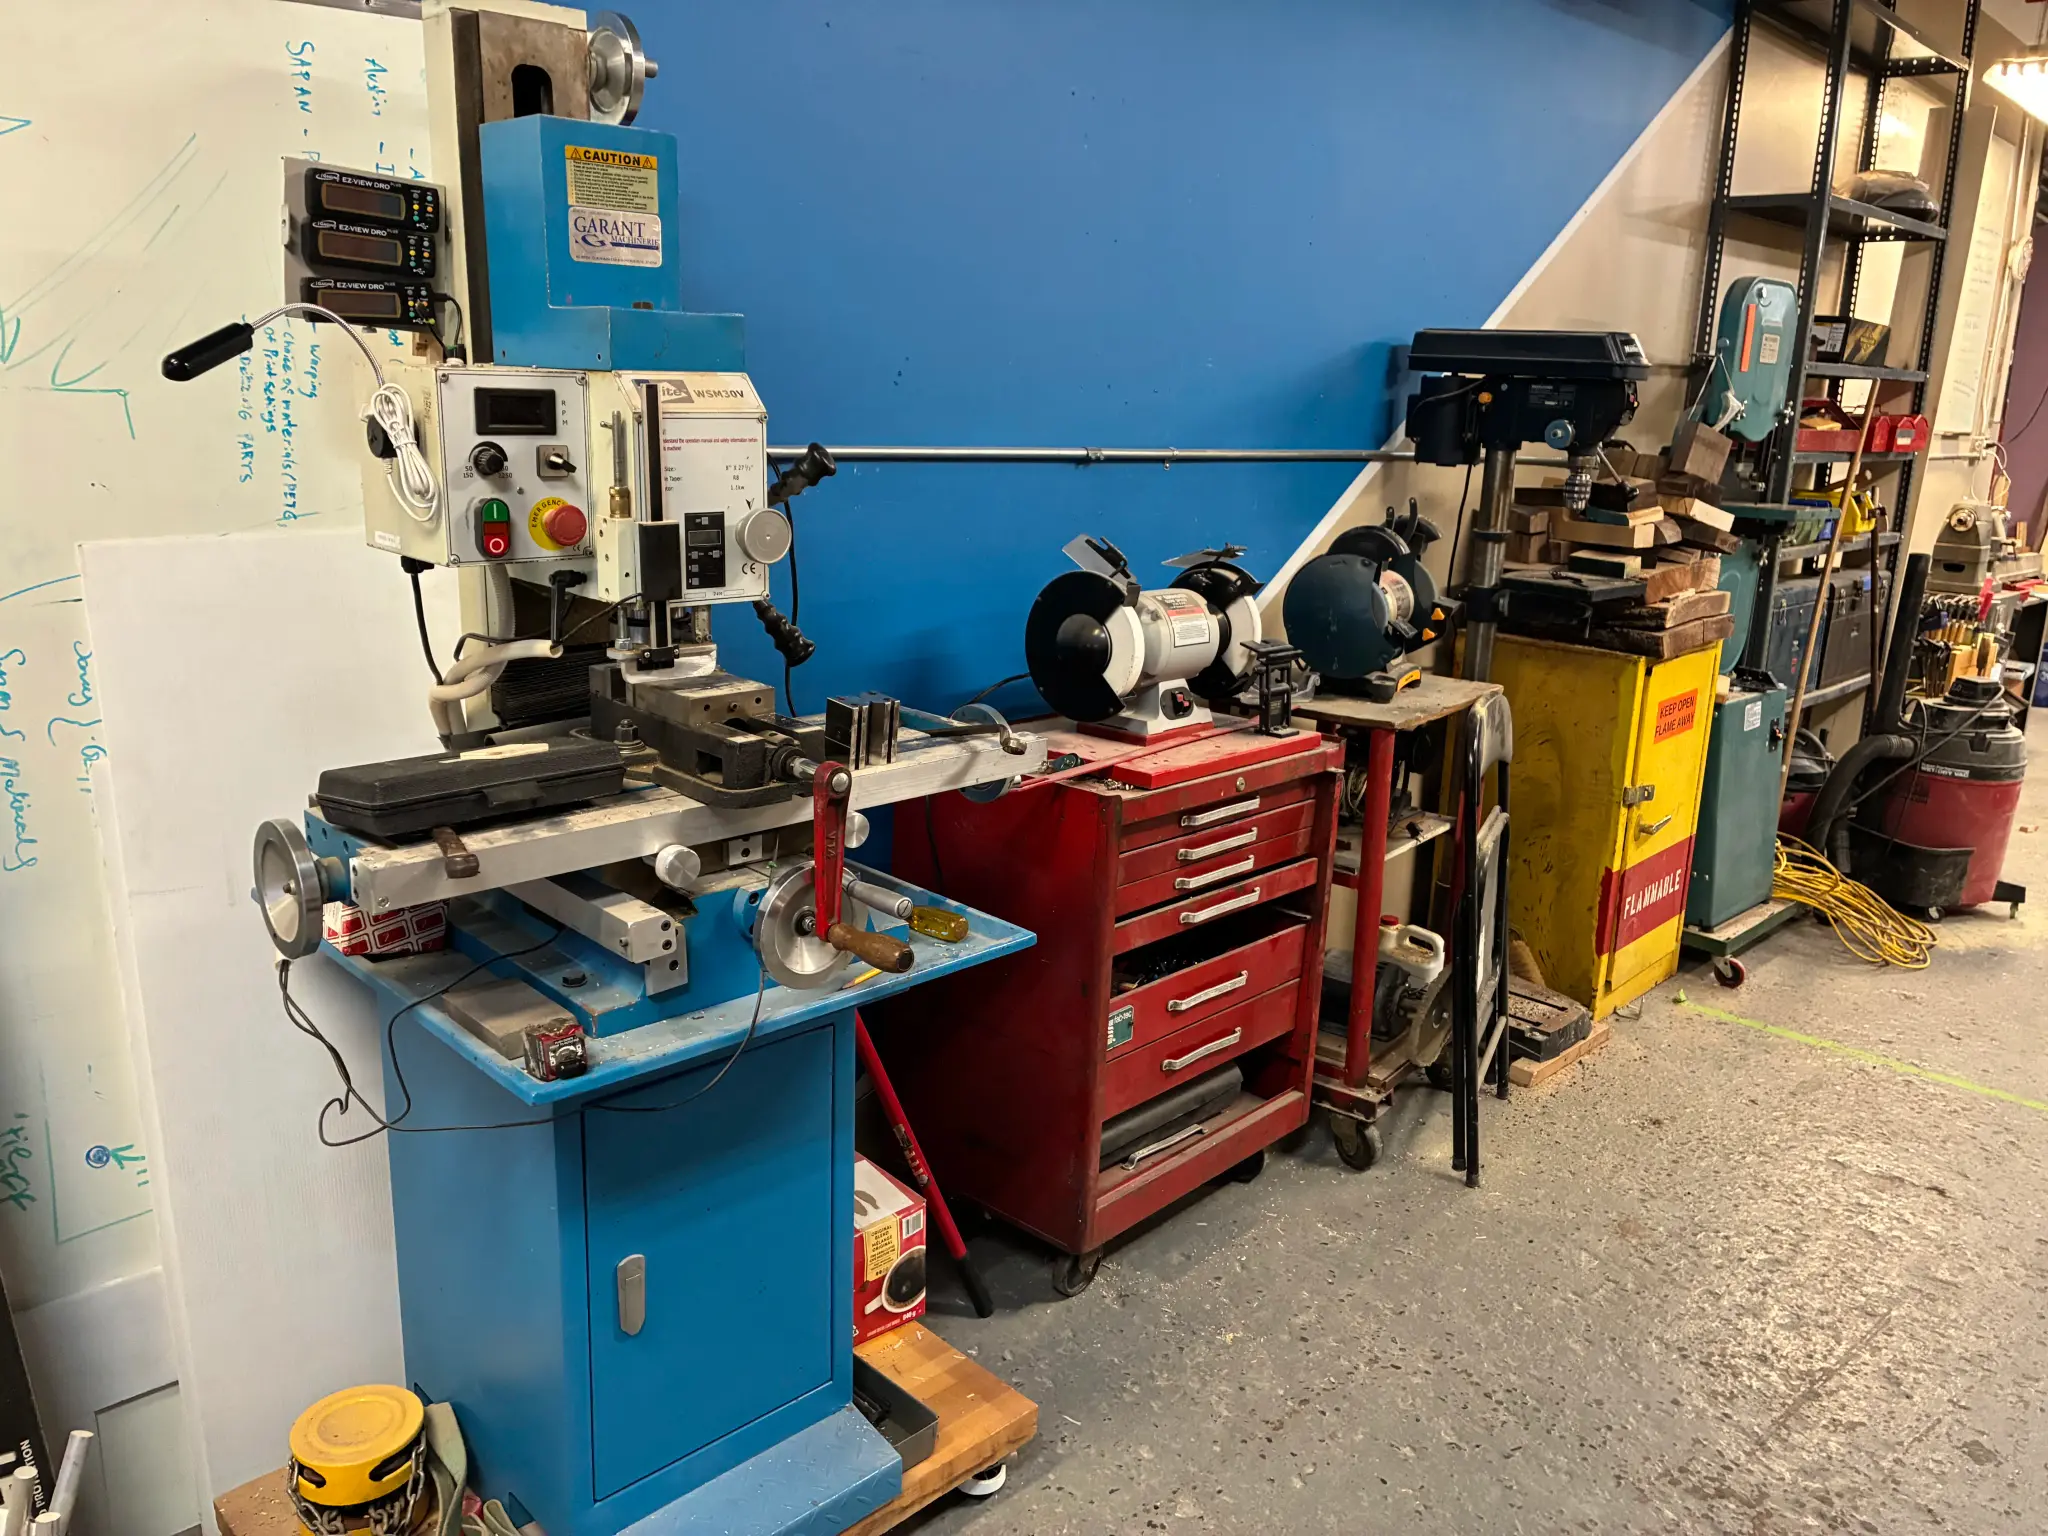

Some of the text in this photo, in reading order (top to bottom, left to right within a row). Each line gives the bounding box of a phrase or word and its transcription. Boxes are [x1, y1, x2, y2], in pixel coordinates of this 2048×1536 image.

[583, 149, 641, 166] CAUTION
[341, 176, 373, 188] EZ-VIEW
[373, 181, 391, 190] DRO
[338, 223, 370, 234] EZ-VIEW
[370, 227, 387, 237] DRO
[573, 216, 646, 238] GARANT
[610, 235, 659, 247] MACHINERIE
[336, 281, 367, 290] EZ-VIEW
[692, 389, 745, 399] WSM30V
[1660, 695, 1696, 719] KEEP OPEN
[1654, 711, 1696, 738] FLAME AWAY
[1623, 868, 1682, 920] FLAMMABLE
[870, 1224, 893, 1237] ORIGINAL
[874, 1231, 890, 1241] BLEND
[871, 1240, 894, 1254] ORIGINAL
